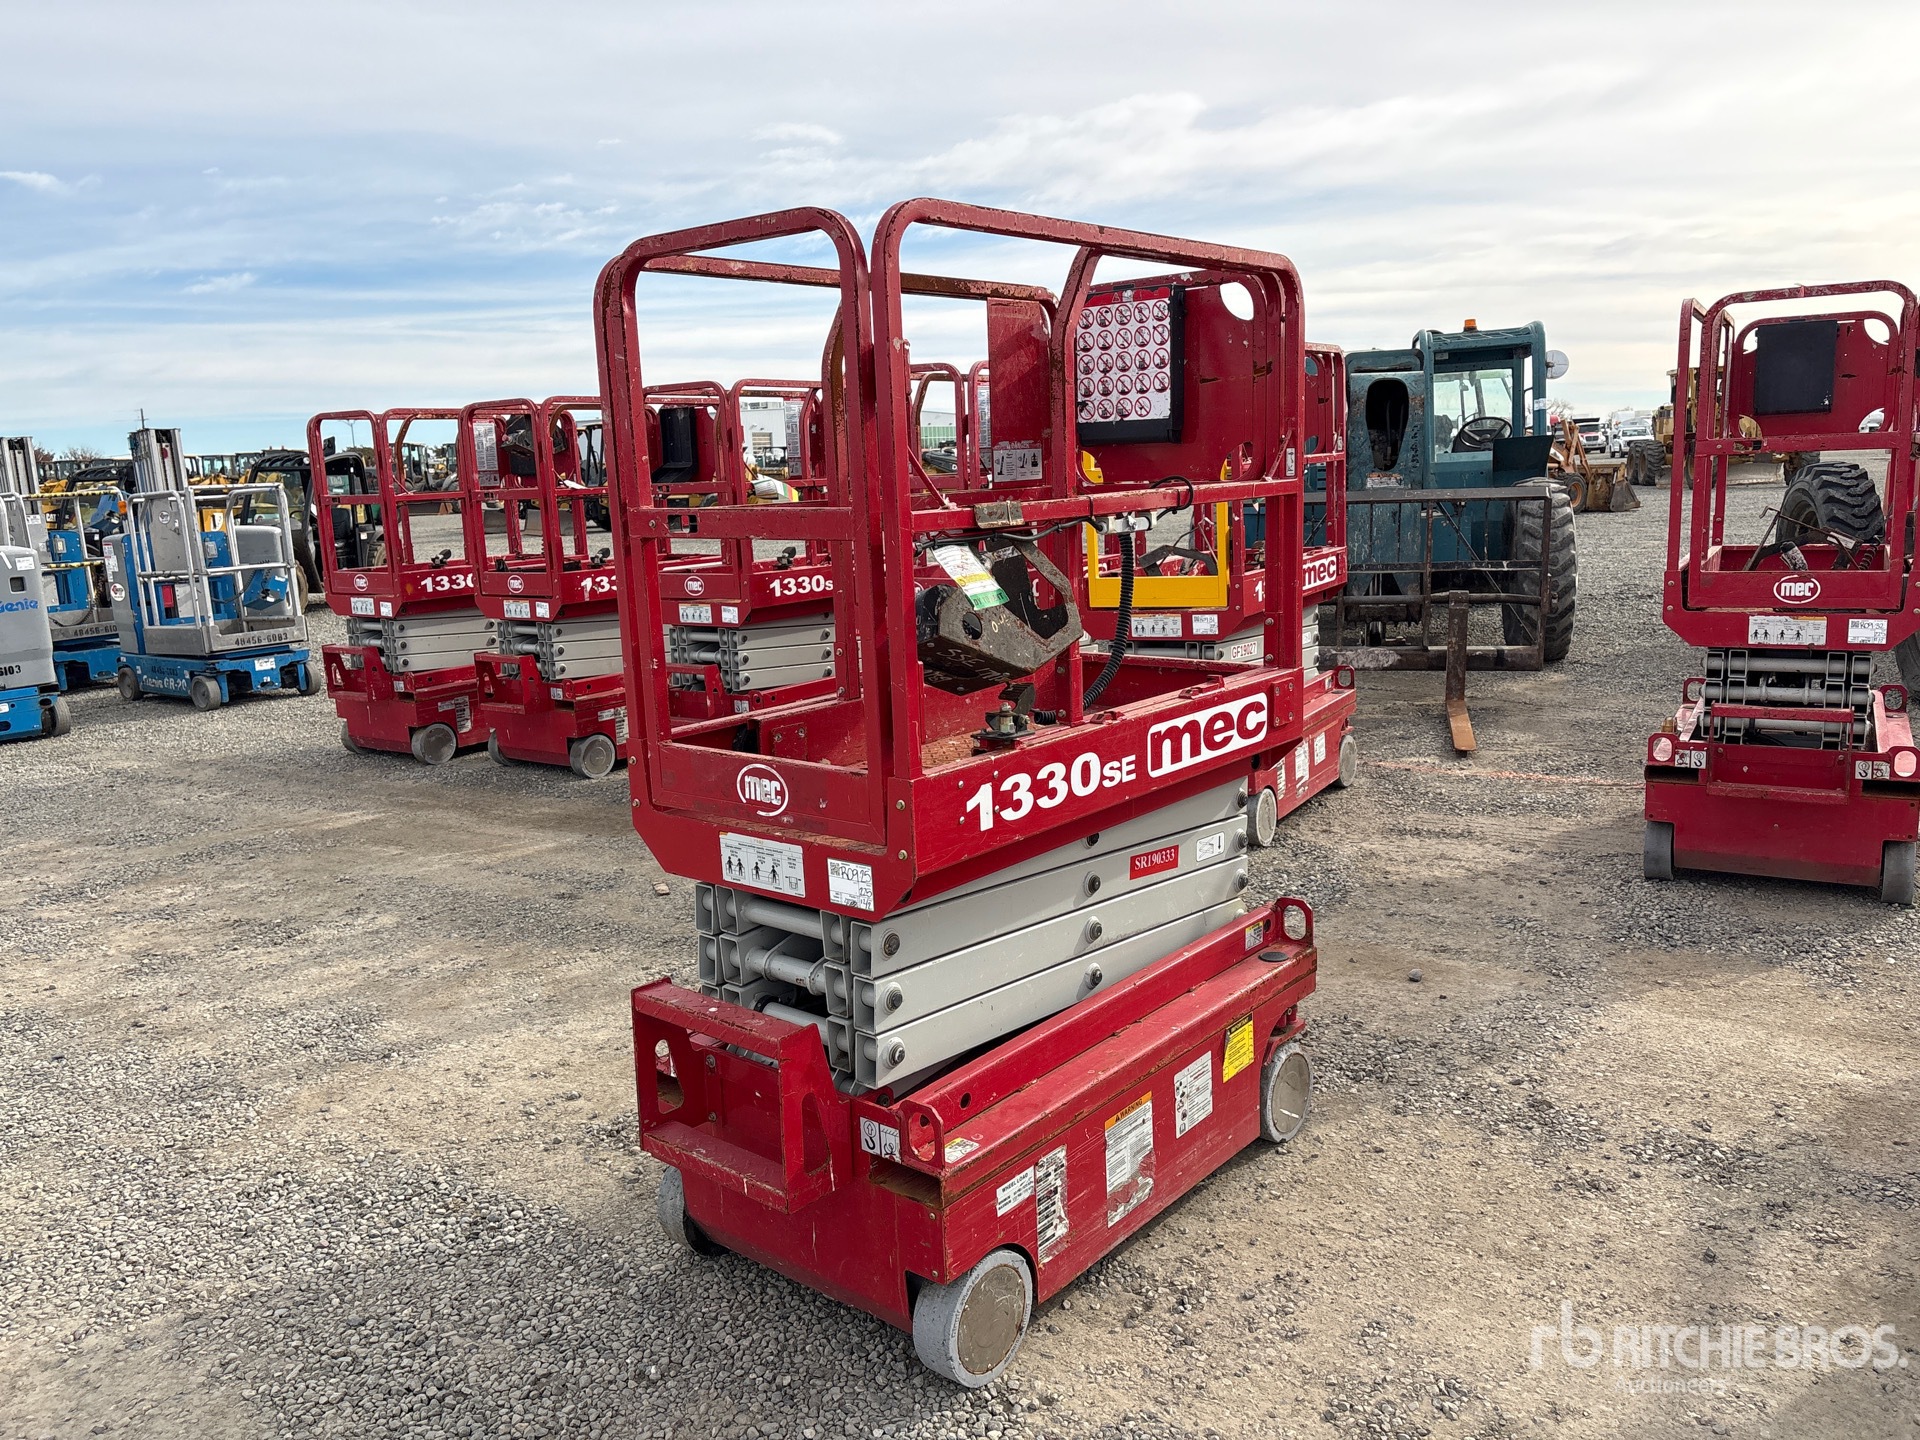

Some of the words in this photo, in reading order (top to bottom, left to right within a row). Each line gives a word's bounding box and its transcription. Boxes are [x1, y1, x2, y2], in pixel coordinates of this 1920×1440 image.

[1780, 582, 1815, 597] mec
[1150, 701, 1266, 773] mec
[743, 774, 782, 806] mec
[1134, 848, 1175, 871] SR190333
[1120, 1098, 1143, 1119] WARNING
[1002, 1179, 1017, 1193] WHEEL
[1017, 1172, 1029, 1184] LOAD
